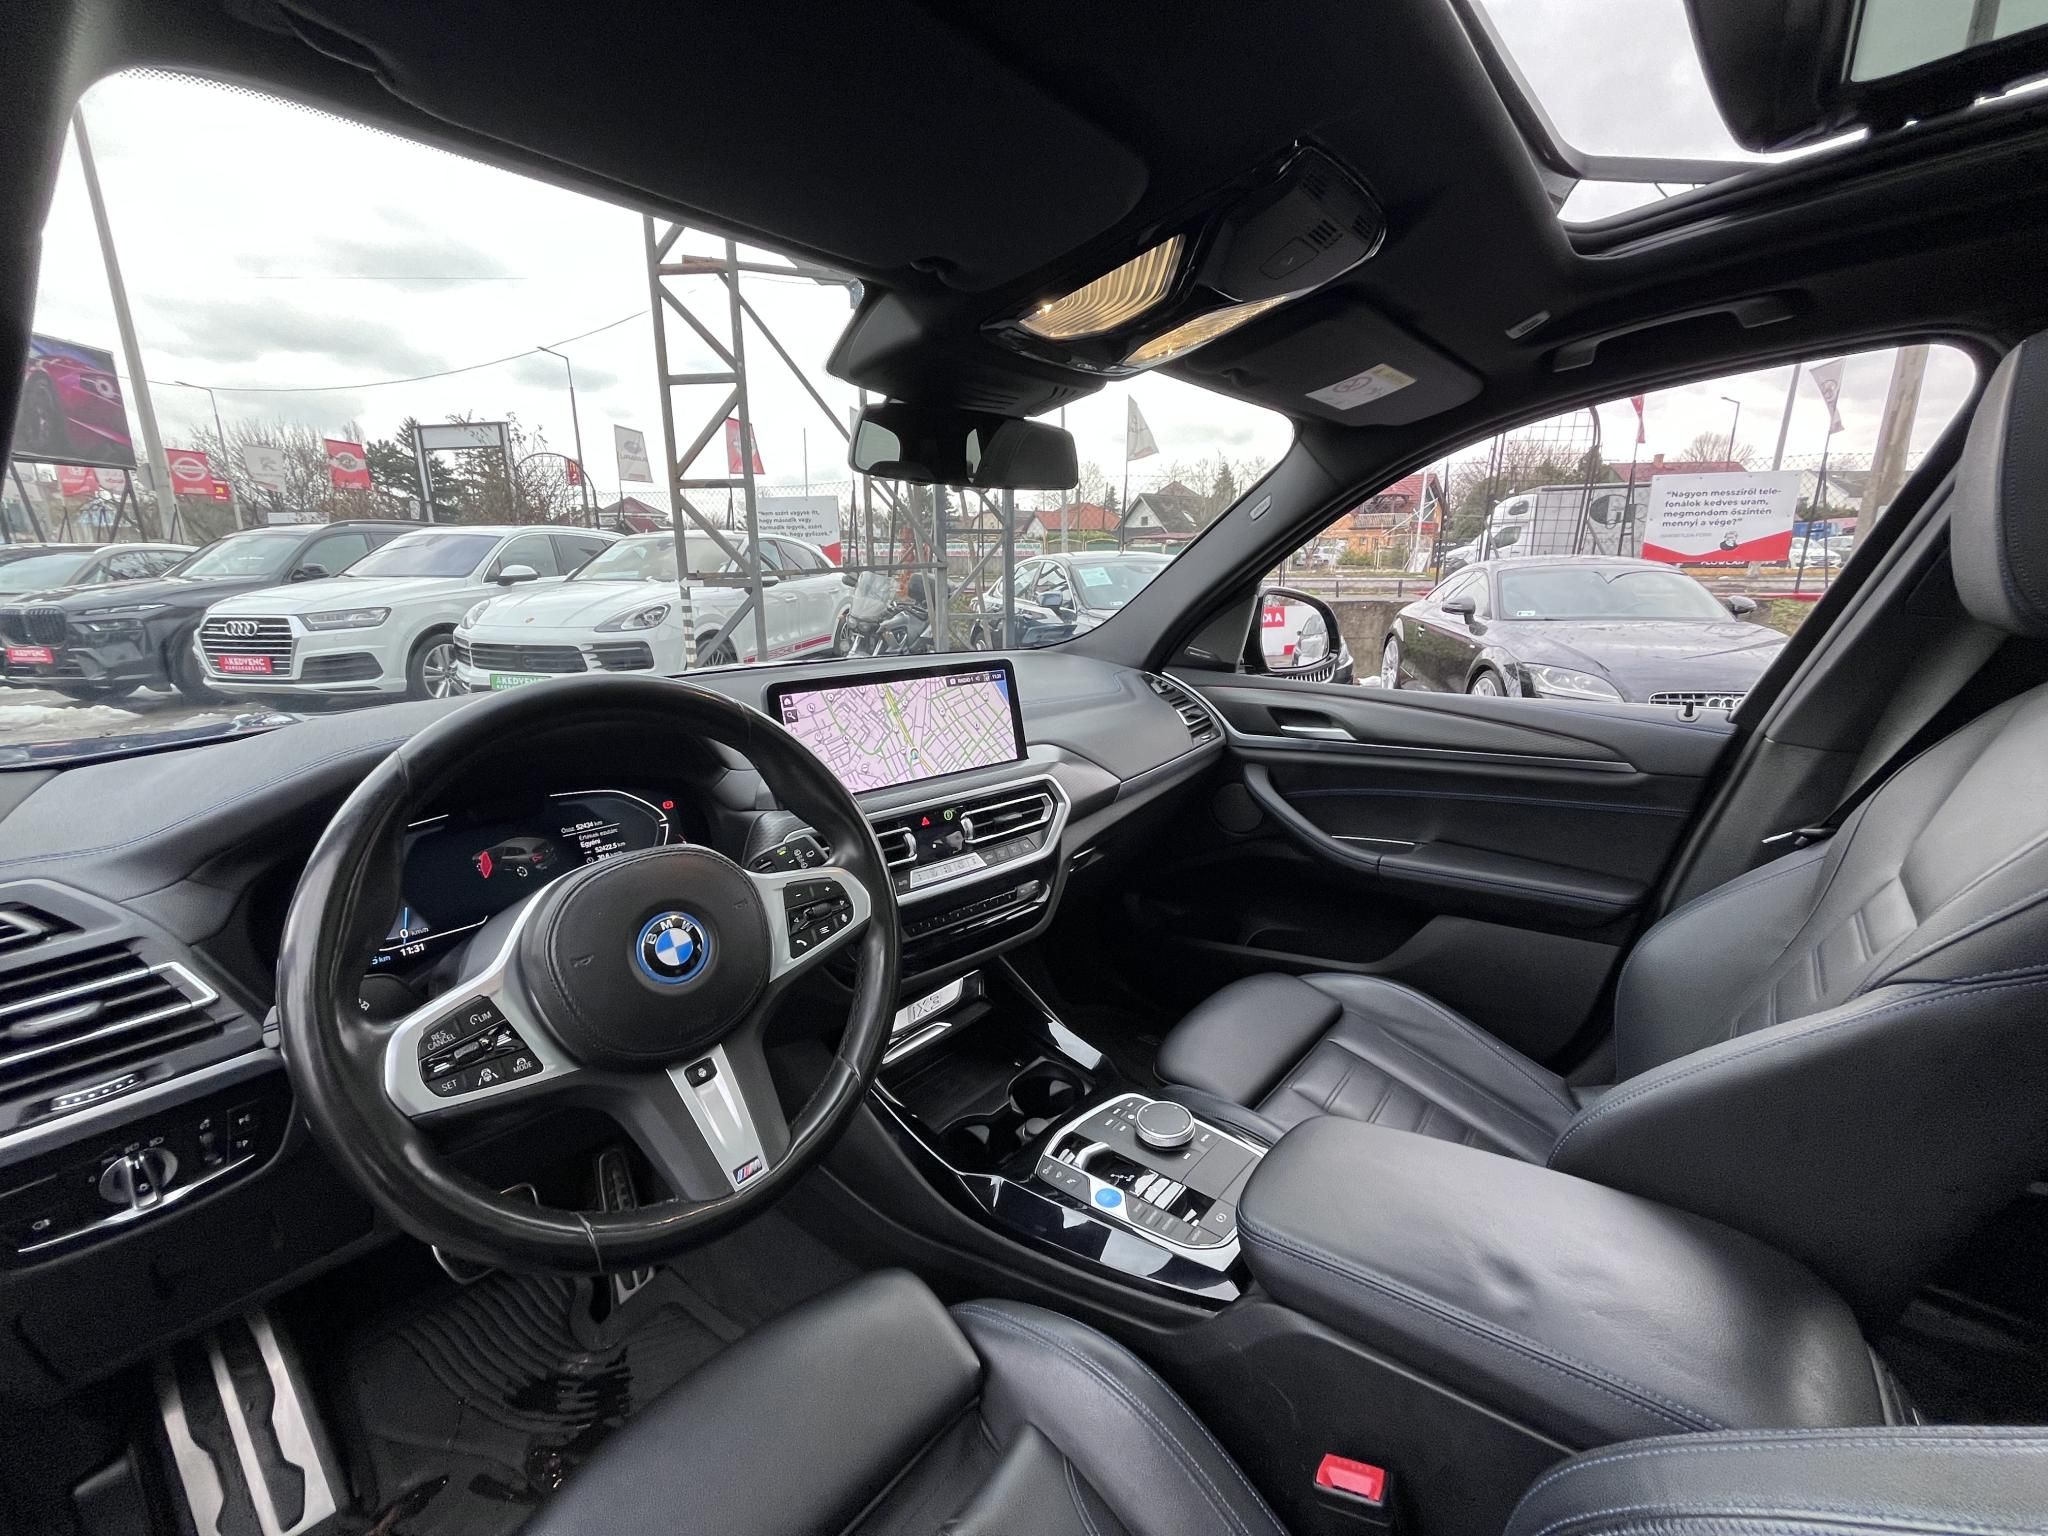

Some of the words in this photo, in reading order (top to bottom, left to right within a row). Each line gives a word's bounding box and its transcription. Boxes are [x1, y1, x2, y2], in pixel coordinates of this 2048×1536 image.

[1665, 500, 1700, 508] fonálok
[1704, 498, 1738, 507] kedves
[1741, 499, 1769, 507] uram,
[1663, 509, 1728, 519] megmondom
[1662, 518, 1698, 528] mennyi
[645, 919, 694, 945] BMW
[400, 943, 425, 956] 11:31
[427, 1033, 456, 1051] CANCEL
[513, 1060, 533, 1074] MODE
[441, 1079, 458, 1092] SET
